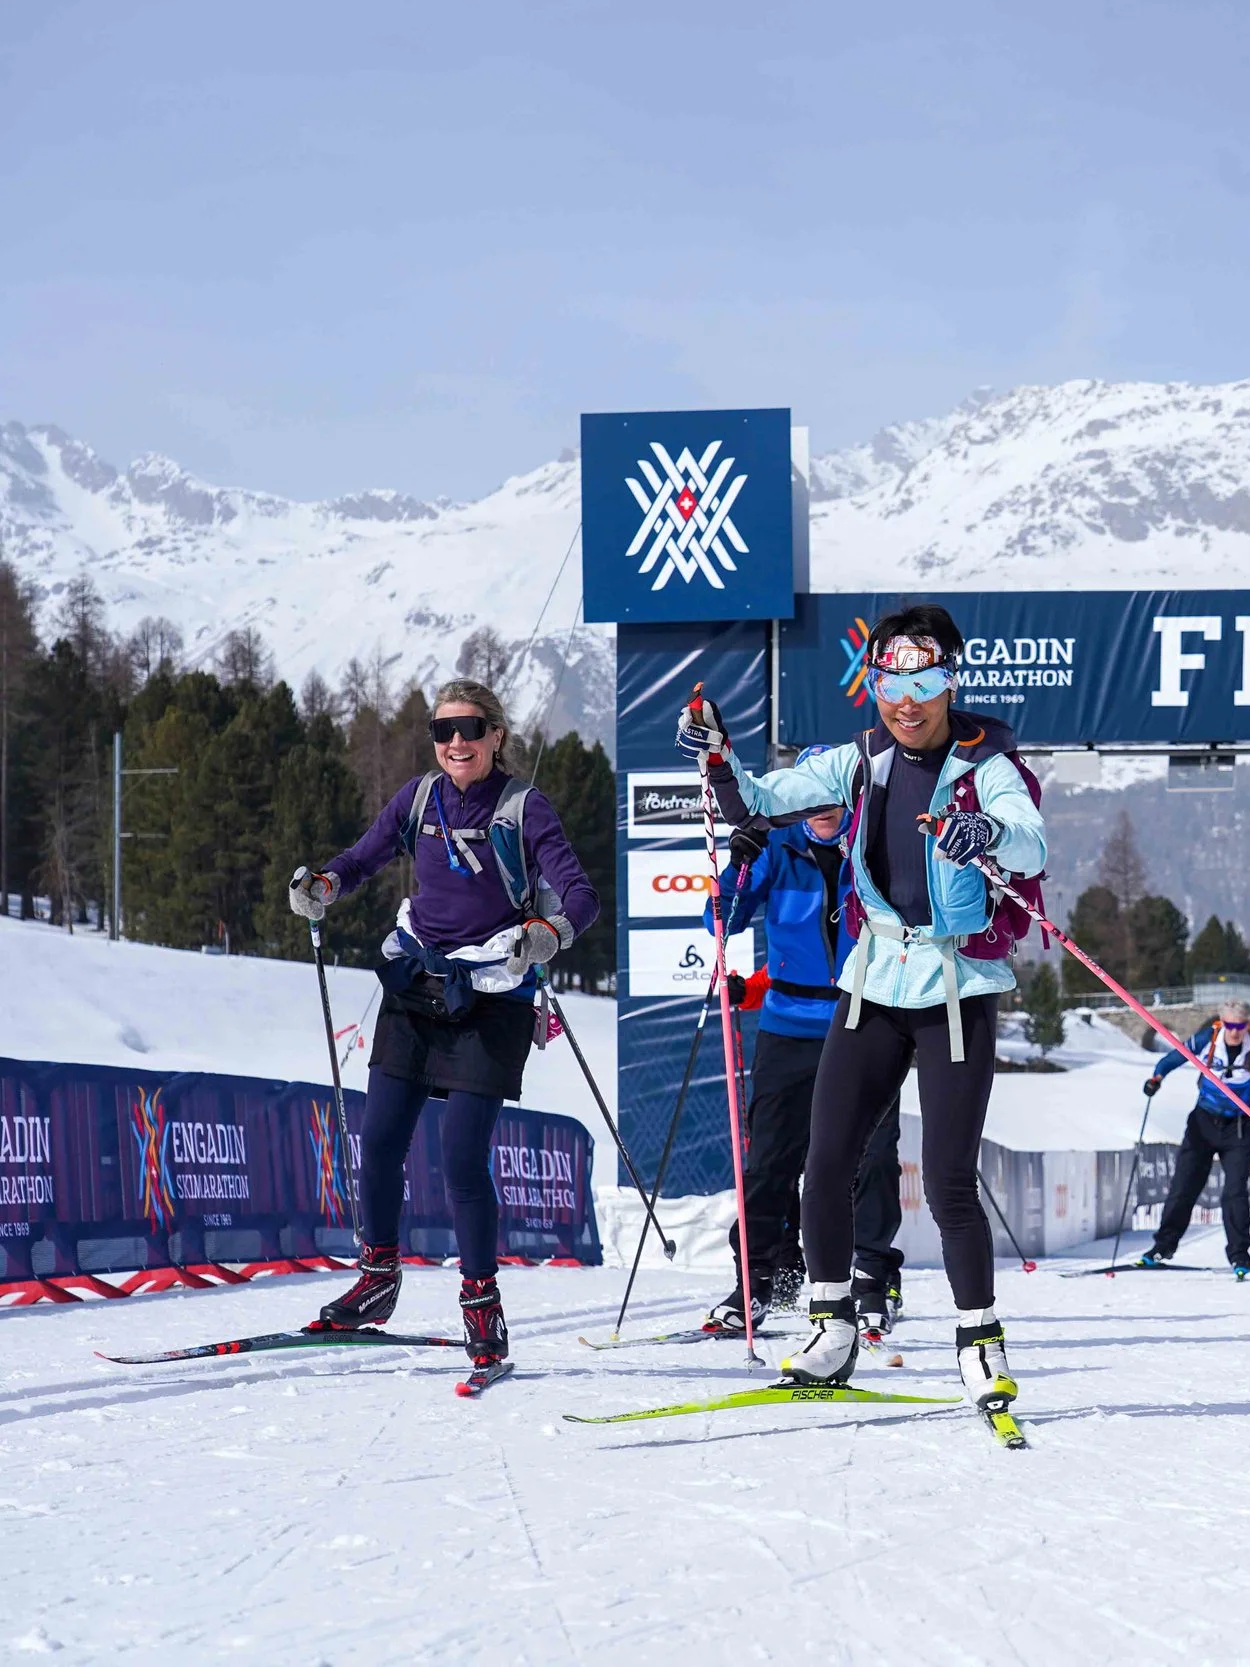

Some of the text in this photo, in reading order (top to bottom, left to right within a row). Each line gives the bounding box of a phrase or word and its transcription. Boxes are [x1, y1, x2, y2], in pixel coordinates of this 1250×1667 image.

[957, 638, 1076, 665] GADIN
[957, 669, 1074, 687] MARATHON
[963, 694, 1025, 704] SINCE 1969
[672, 970, 711, 981] odlo
[172, 1122, 247, 1165] ENGADIN
[498, 1145, 573, 1184] ENGADIN
[176, 1175, 250, 1200] SKIMARATHON
[203, 1214, 220, 1226] SINCE
[14, 1222, 30, 1236] 1969
[791, 1390, 834, 1400] FISCHER
